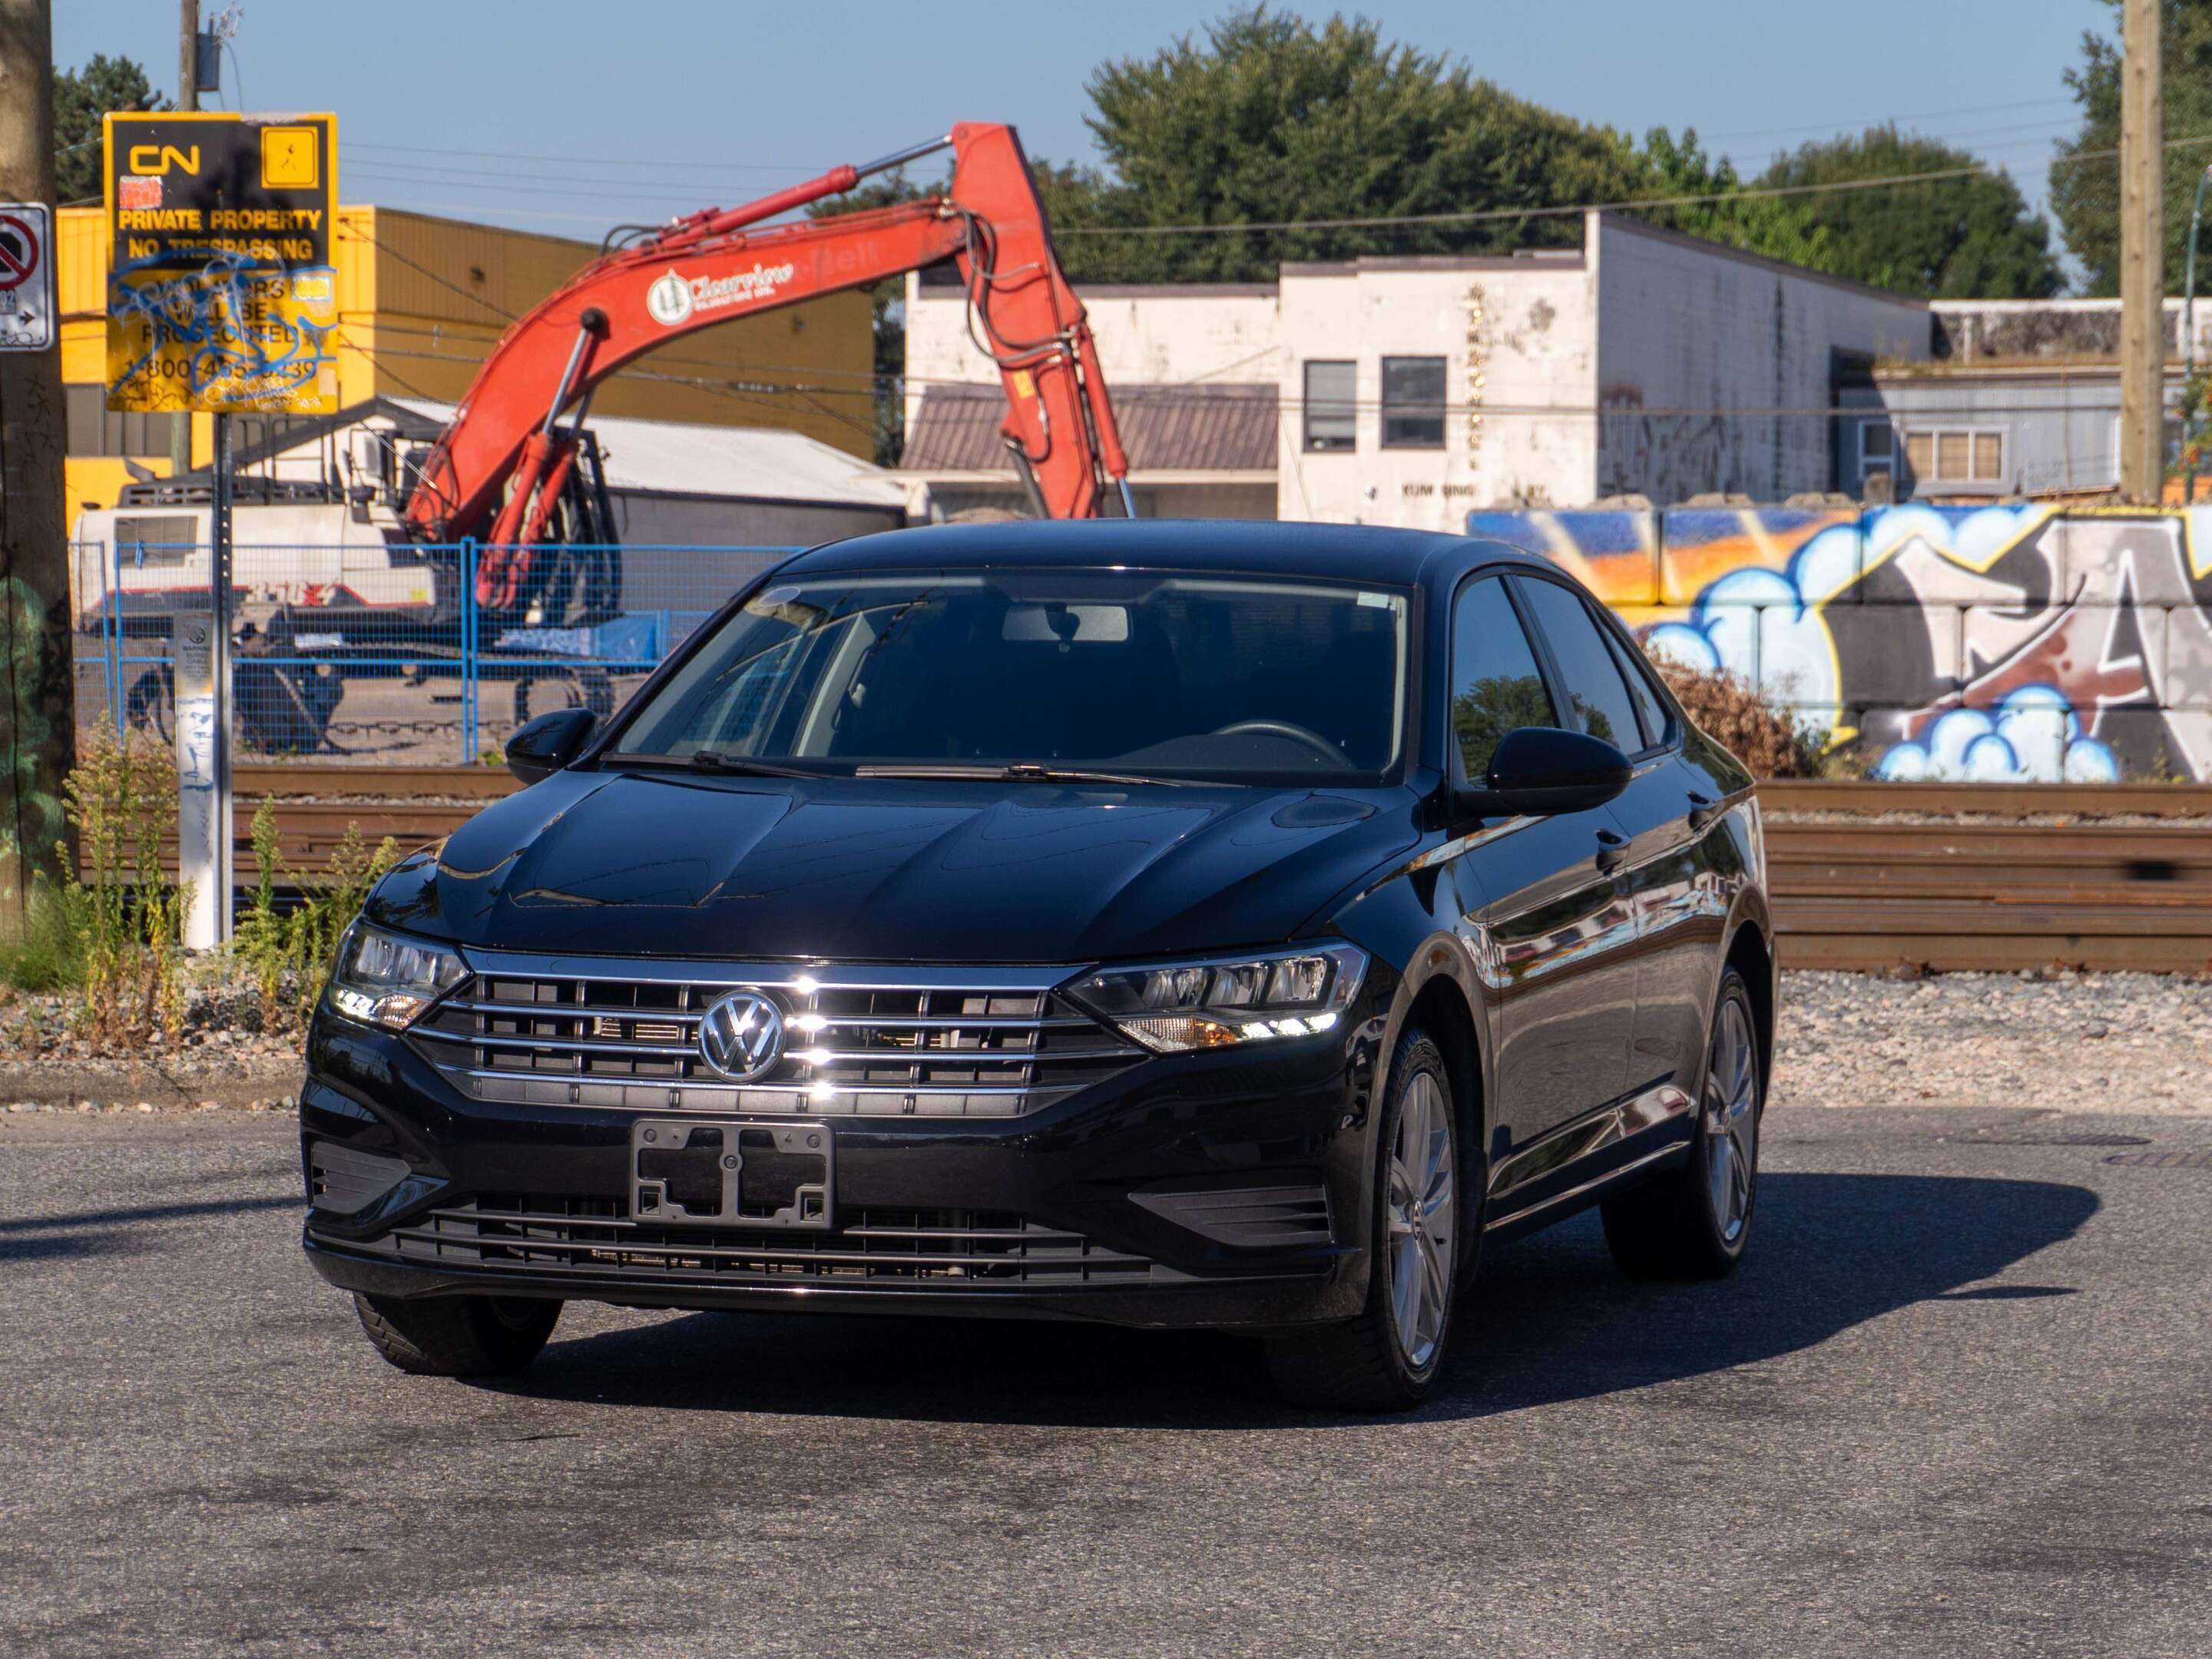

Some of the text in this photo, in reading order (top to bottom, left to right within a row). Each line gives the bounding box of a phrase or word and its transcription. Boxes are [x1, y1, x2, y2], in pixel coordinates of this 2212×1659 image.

[130, 144, 200, 175] CN
[118, 209, 322, 230] PRIVATE PROPERTY
[128, 238, 313, 259] NO TRESPASSING
[242, 302, 267, 320] BE
